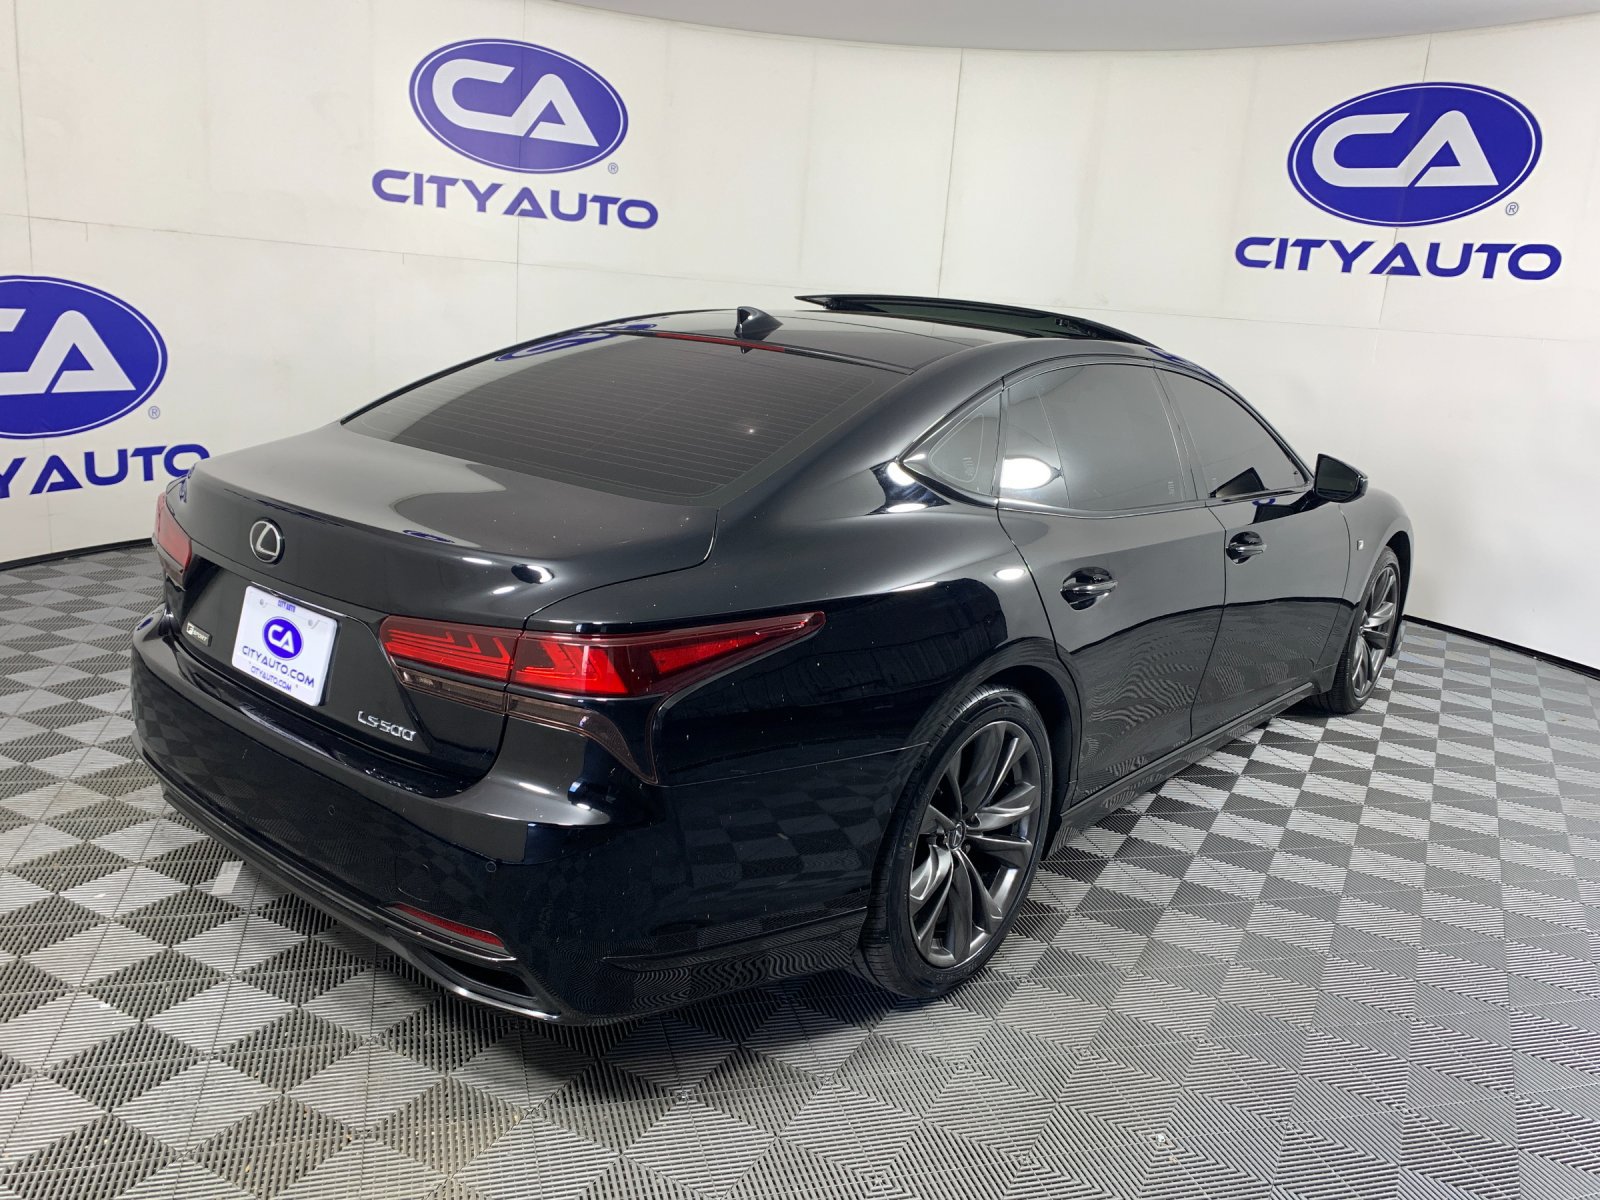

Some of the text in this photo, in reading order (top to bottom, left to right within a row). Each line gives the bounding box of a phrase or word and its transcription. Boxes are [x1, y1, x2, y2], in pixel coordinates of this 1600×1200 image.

[431, 58, 600, 147] CA
[1311, 109, 1500, 188] CA
[0, 308, 137, 397] A
[267, 623, 296, 655] CA
